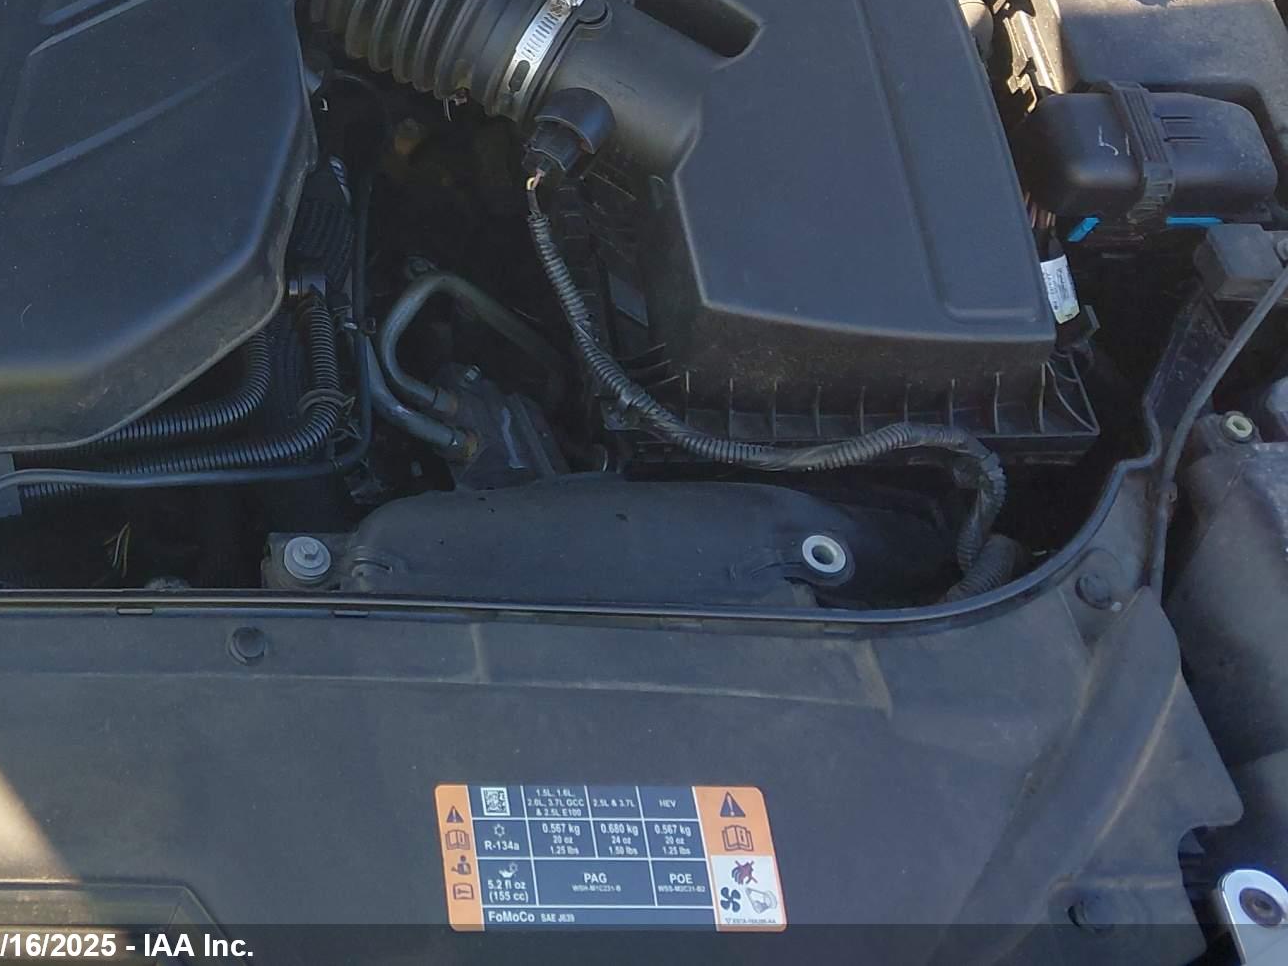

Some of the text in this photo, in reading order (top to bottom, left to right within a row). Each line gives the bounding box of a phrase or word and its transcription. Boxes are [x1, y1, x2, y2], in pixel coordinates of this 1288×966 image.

[657, 799, 677, 808] HEV
[535, 808, 543, 817] &
[541, 823, 581, 836] 0.567 kg
[600, 823, 640, 836] 0.680 kg
[654, 824, 692, 837] 0.567 kg
[553, 835, 575, 844] 20 oz
[611, 835, 633, 845] 24 oz
[665, 836, 686, 845] 20 oz
[484, 840, 520, 851] R-134a
[550, 845, 580, 855] 1.25 lbs
[625, 846, 639, 855] lbs
[662, 846, 692, 856] 1.25 lbs
[583, 872, 608, 884] PAG
[669, 873, 694, 885] POE
[487, 879, 527, 890] 5.2 fl oz
[489, 890, 530, 904] (155 cc)
[488, 910, 536, 923] FoMoCo
[540, 913, 557, 923] SAE
